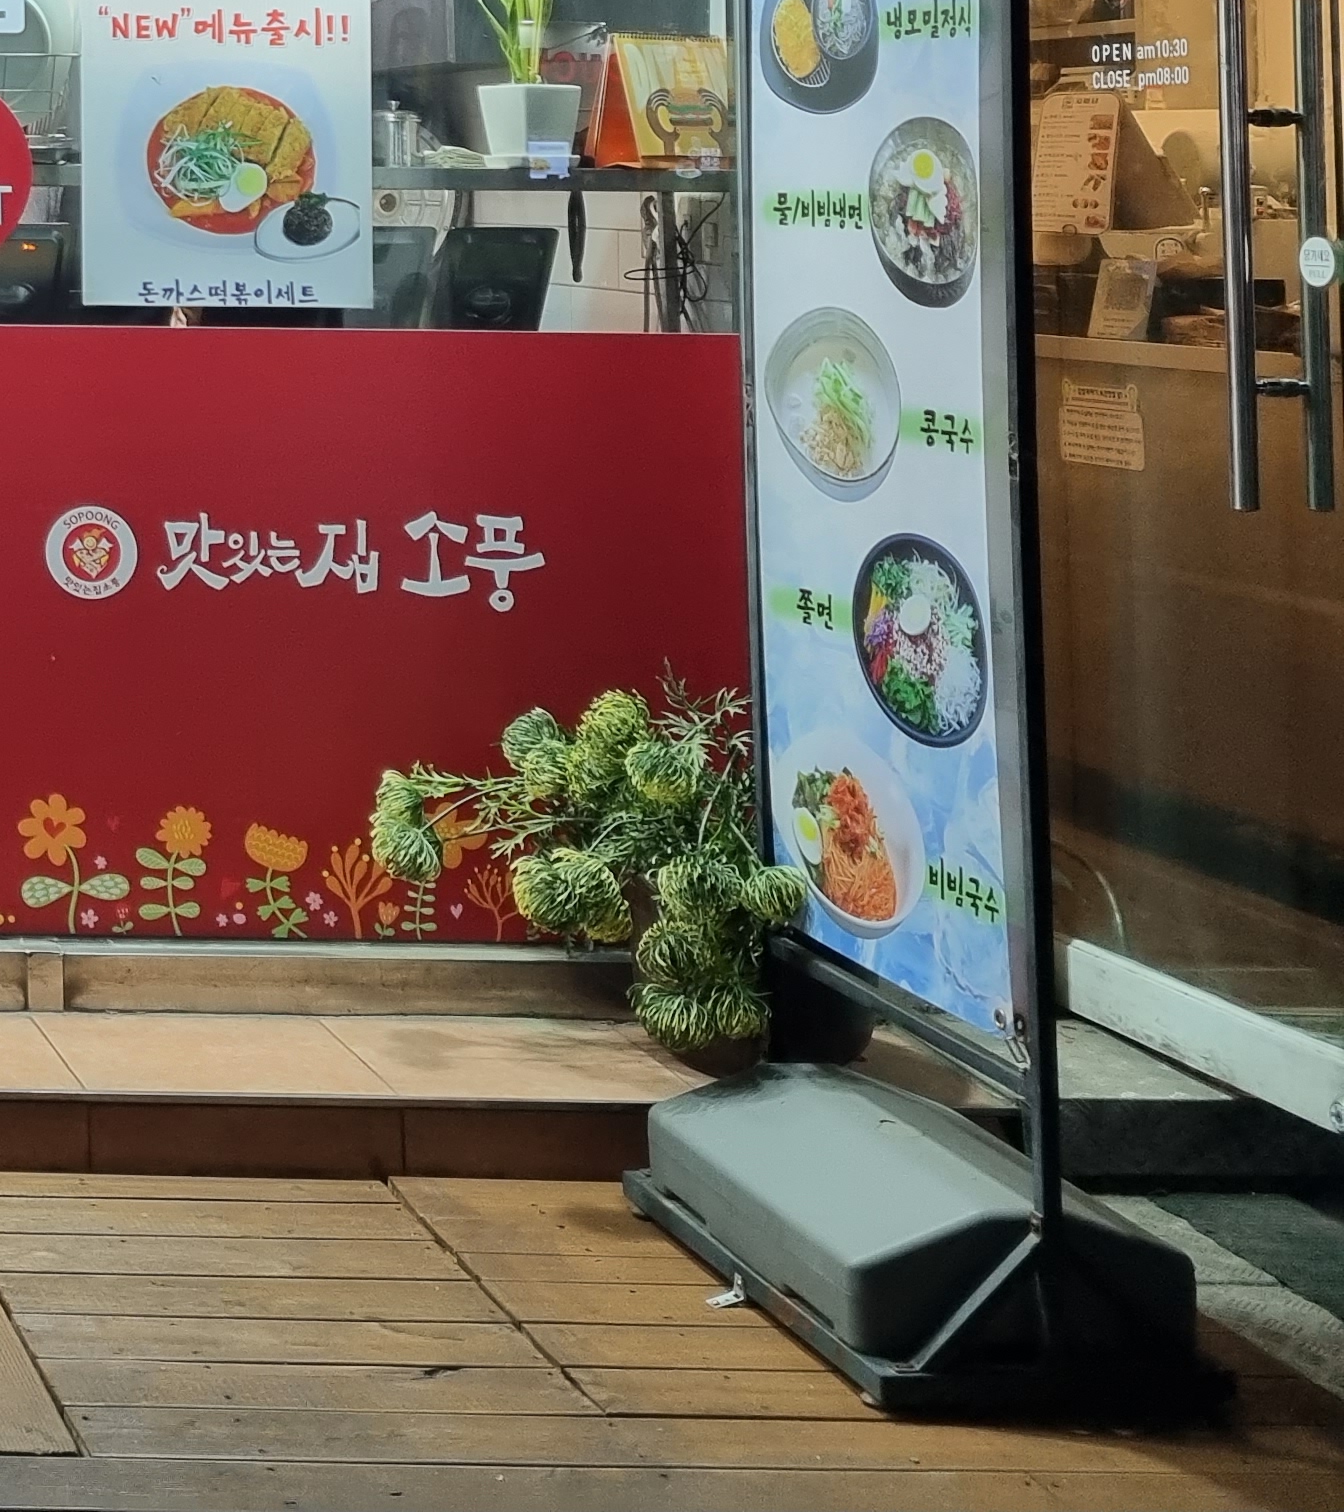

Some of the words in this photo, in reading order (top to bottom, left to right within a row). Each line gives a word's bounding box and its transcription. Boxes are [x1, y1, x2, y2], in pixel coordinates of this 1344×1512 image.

[1091, 42, 1133, 64] OPEN
[1136, 38, 1189, 61] am10:30
[1092, 69, 1132, 90] CLOSE
[1138, 65, 1190, 92] pm08:00
[137, 279, 320, 307] 돈까스떡볶이세트
[919, 409, 975, 455] 콩국수
[61, 509, 122, 532] SOPOONG
[157, 511, 381, 595] 맛있는집
[400, 510, 547, 613] 소풍
[796, 589, 834, 633] 쫄면
[927, 859, 1001, 924] 비빔국수
